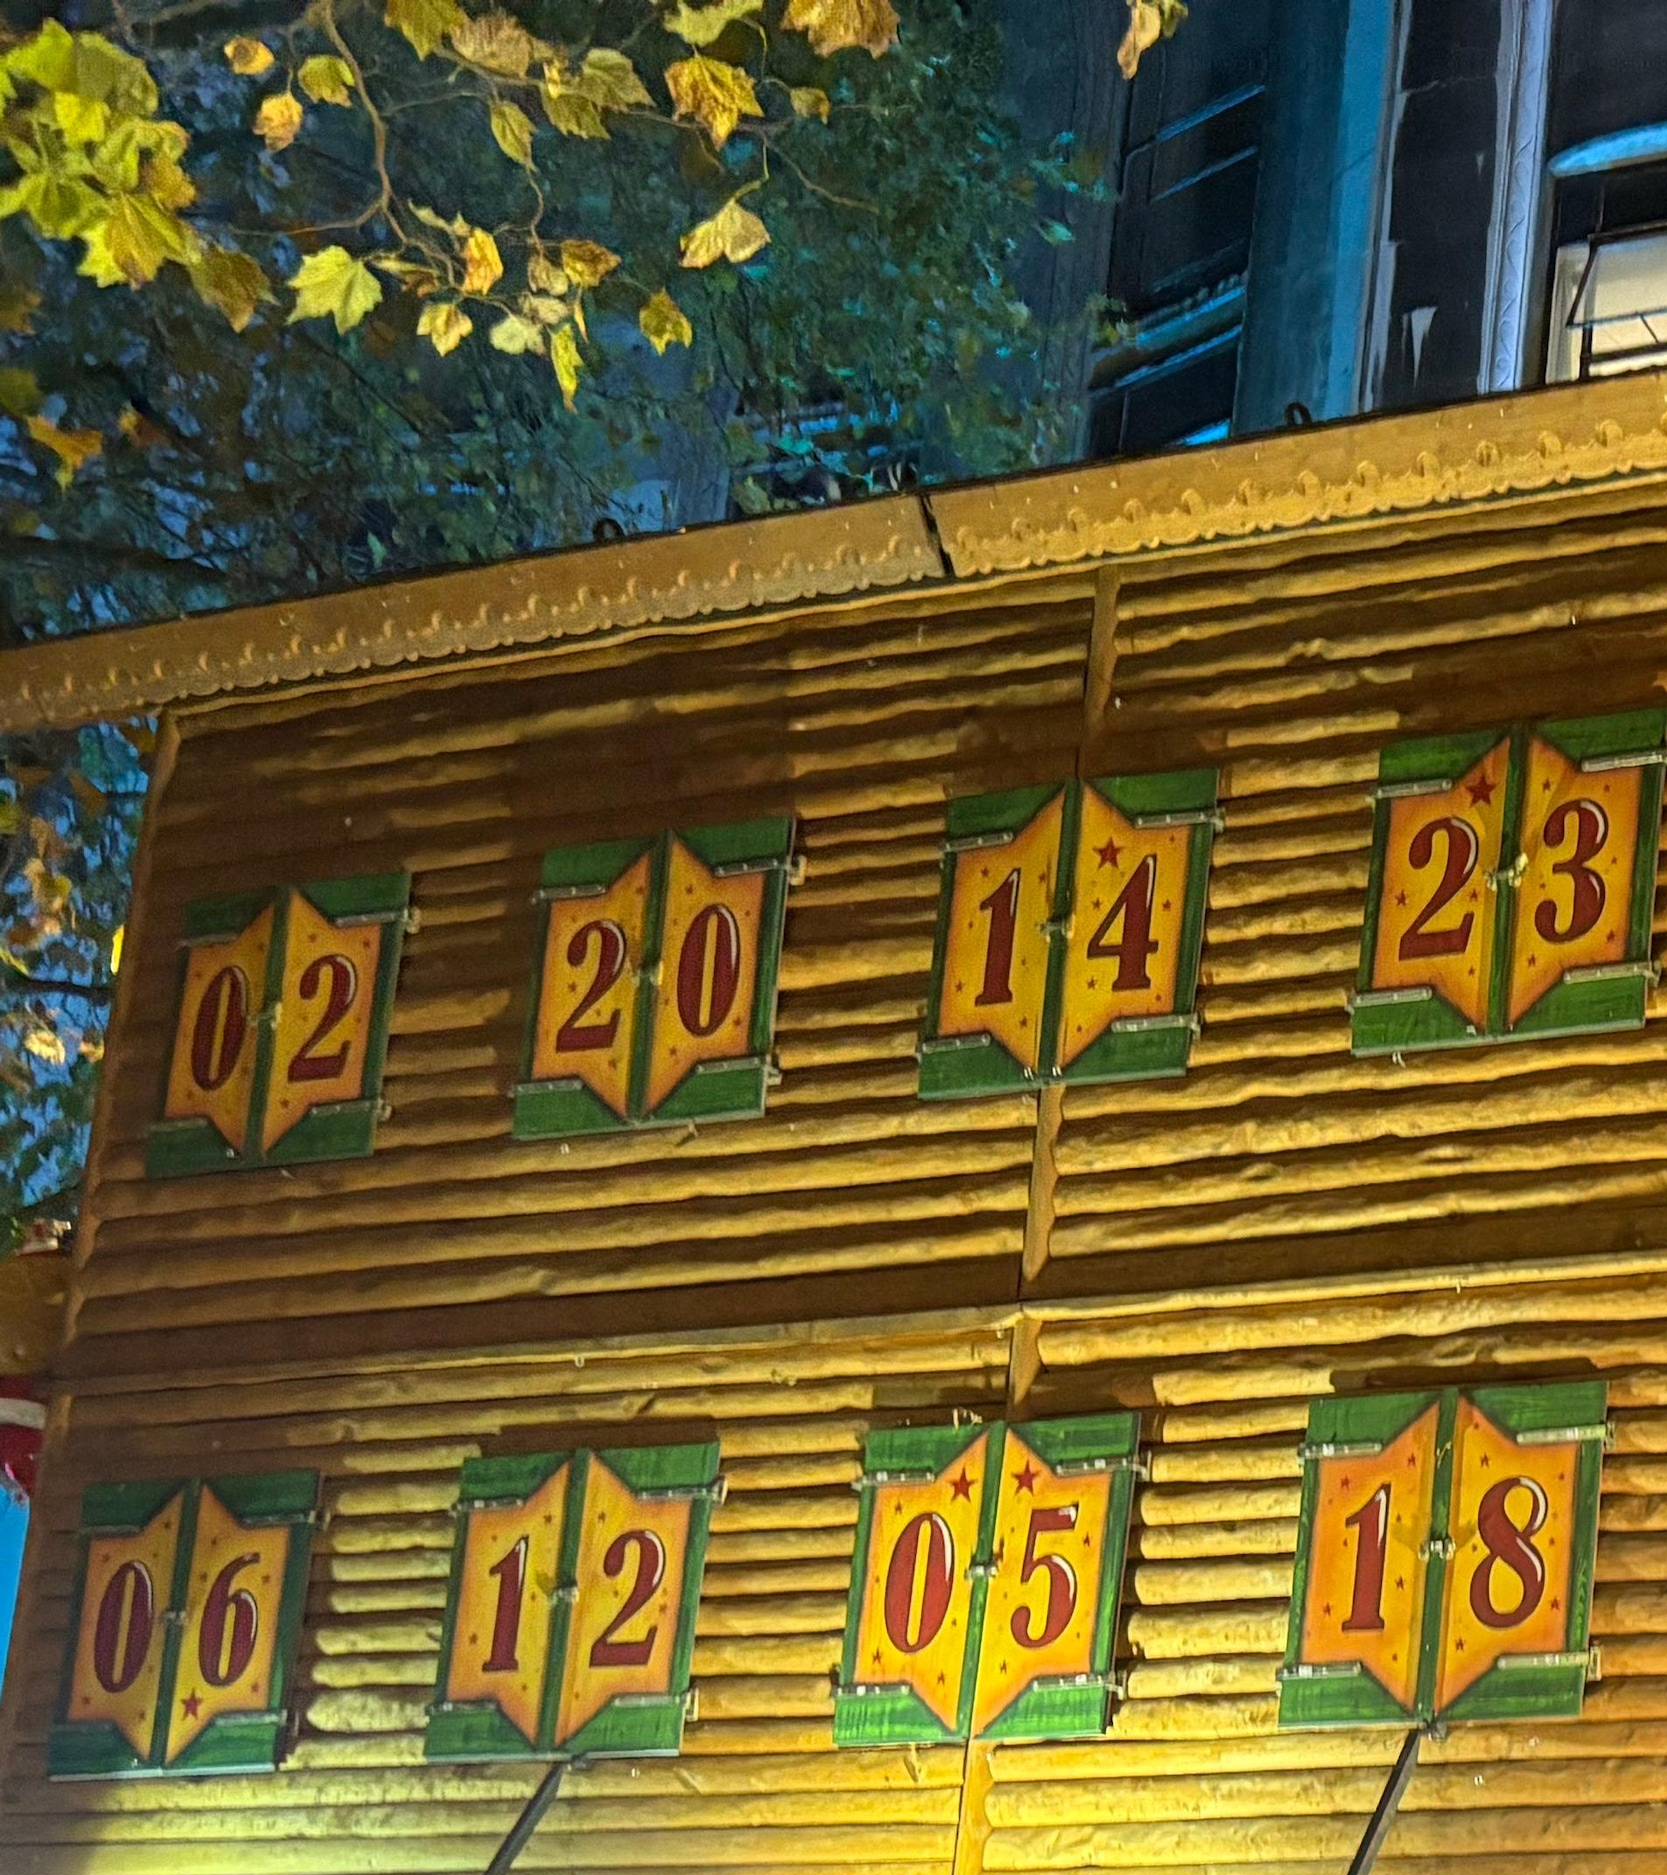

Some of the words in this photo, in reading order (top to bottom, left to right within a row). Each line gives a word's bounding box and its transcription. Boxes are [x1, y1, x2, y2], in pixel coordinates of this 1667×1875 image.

[973, 854, 1162, 1007] 14
[1398, 798, 1609, 962] 23
[190, 953, 358, 1092] 02
[555, 902, 741, 1054] 20
[92, 1552, 260, 1694] 06
[481, 1528, 667, 1674] 12
[883, 1504, 1078, 1656] 05
[1341, 1474, 1550, 1634] 18
